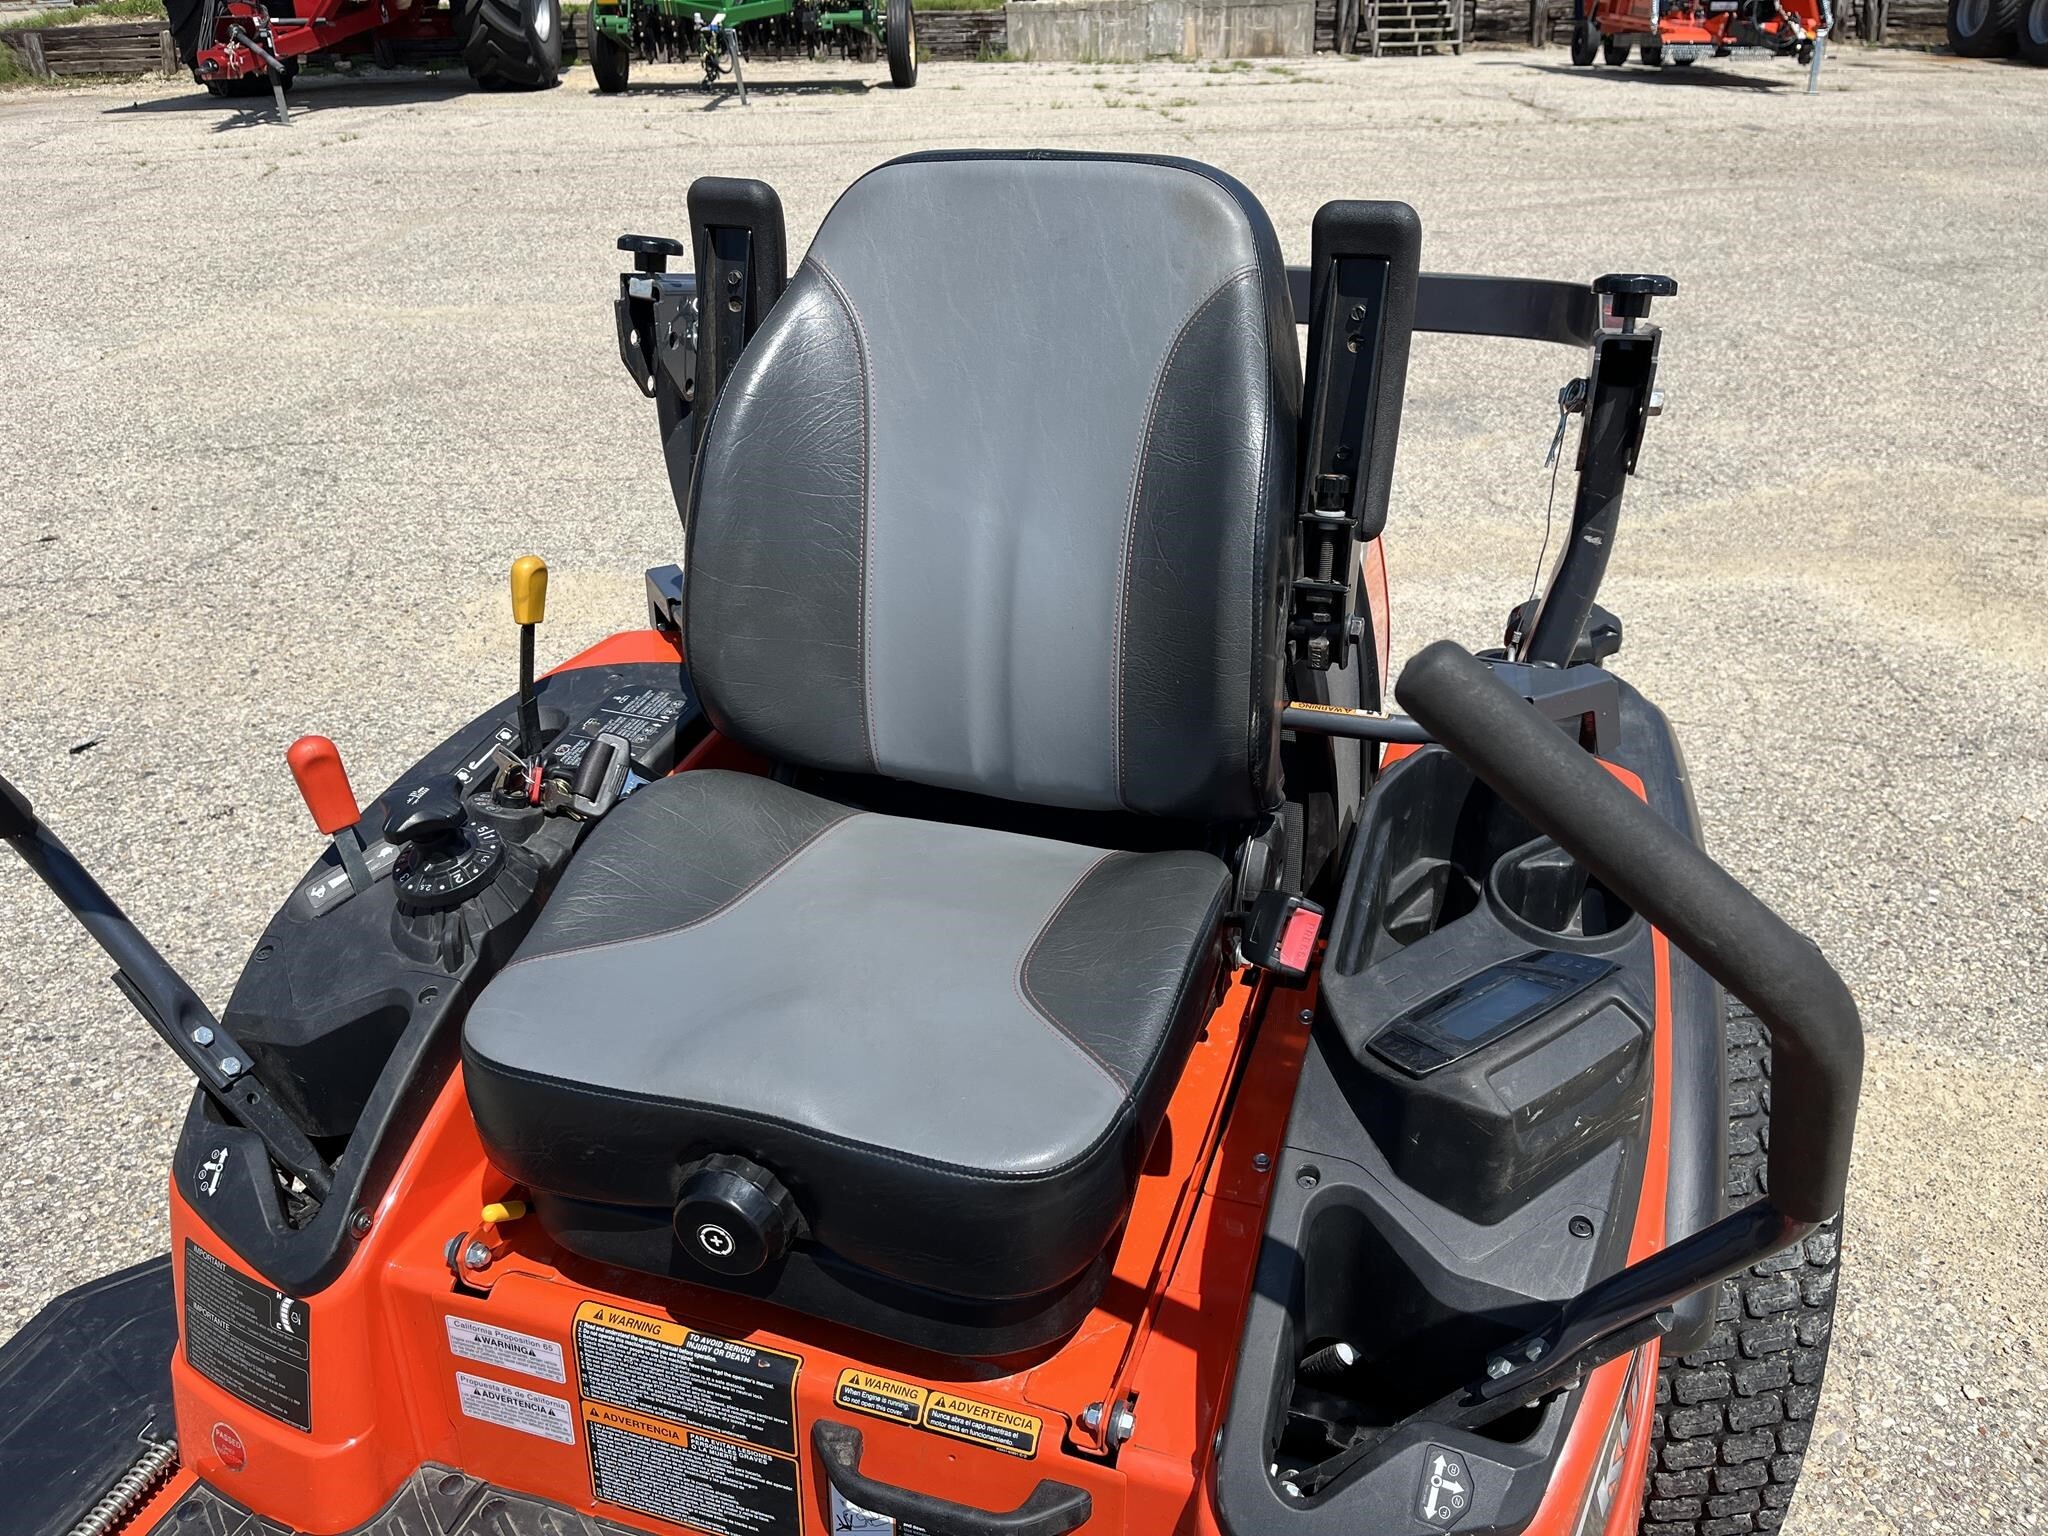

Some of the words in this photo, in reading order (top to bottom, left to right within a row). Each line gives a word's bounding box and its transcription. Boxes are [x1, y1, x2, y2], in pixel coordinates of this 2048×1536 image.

[1298, 703, 1343, 713] WARNING
[477, 825, 489, 833] 5
[1298, 923, 1315, 958] PRESS
[193, 1245, 226, 1271] IMPORTANT
[192, 1301, 231, 1332] IMPORTANTE
[608, 1313, 662, 1336] WARNING
[453, 1320, 493, 1336] California
[494, 1330, 541, 1347] Proposition
[542, 1343, 554, 1352] 65
[481, 1336, 529, 1355] WARNING
[690, 1333, 700, 1342] TO
[700, 1336, 724, 1347] AVOID
[723, 1342, 757, 1357] SERIOUS
[686, 1341, 713, 1354] INJURY
[713, 1348, 724, 1357] OR
[725, 1350, 751, 1364] DEATH
[460, 1375, 500, 1392] Propuesta
[502, 1387, 512, 1396] 65
[514, 1389, 525, 1398] de
[527, 1393, 566, 1410] California
[844, 1386, 860, 1397] When
[861, 1392, 881, 1402] Engine
[864, 1377, 918, 1399] WARNING
[482, 1391, 547, 1414] ADVERTENCIA
[860, 1400, 875, 1408] open
[875, 1403, 886, 1411] this
[886, 1407, 903, 1416] cover.
[603, 1412, 680, 1439] ADVERTENCIA
[930, 1419, 947, 1428] motor
[931, 1410, 951, 1420] Nunca
[951, 1415, 964, 1424] abra
[986, 1426, 1012, 1438] mientras
[949, 1400, 1033, 1430] ADVERTENCIA
[690, 1433, 710, 1444] PARA
[711, 1438, 736, 1450] EVITAR
[737, 1447, 773, 1461] LESIONES
[690, 1439, 737, 1456] PERSONALES
[738, 1452, 768, 1465] GRAVES
[709, 1450, 737, 1461] MUERTE
